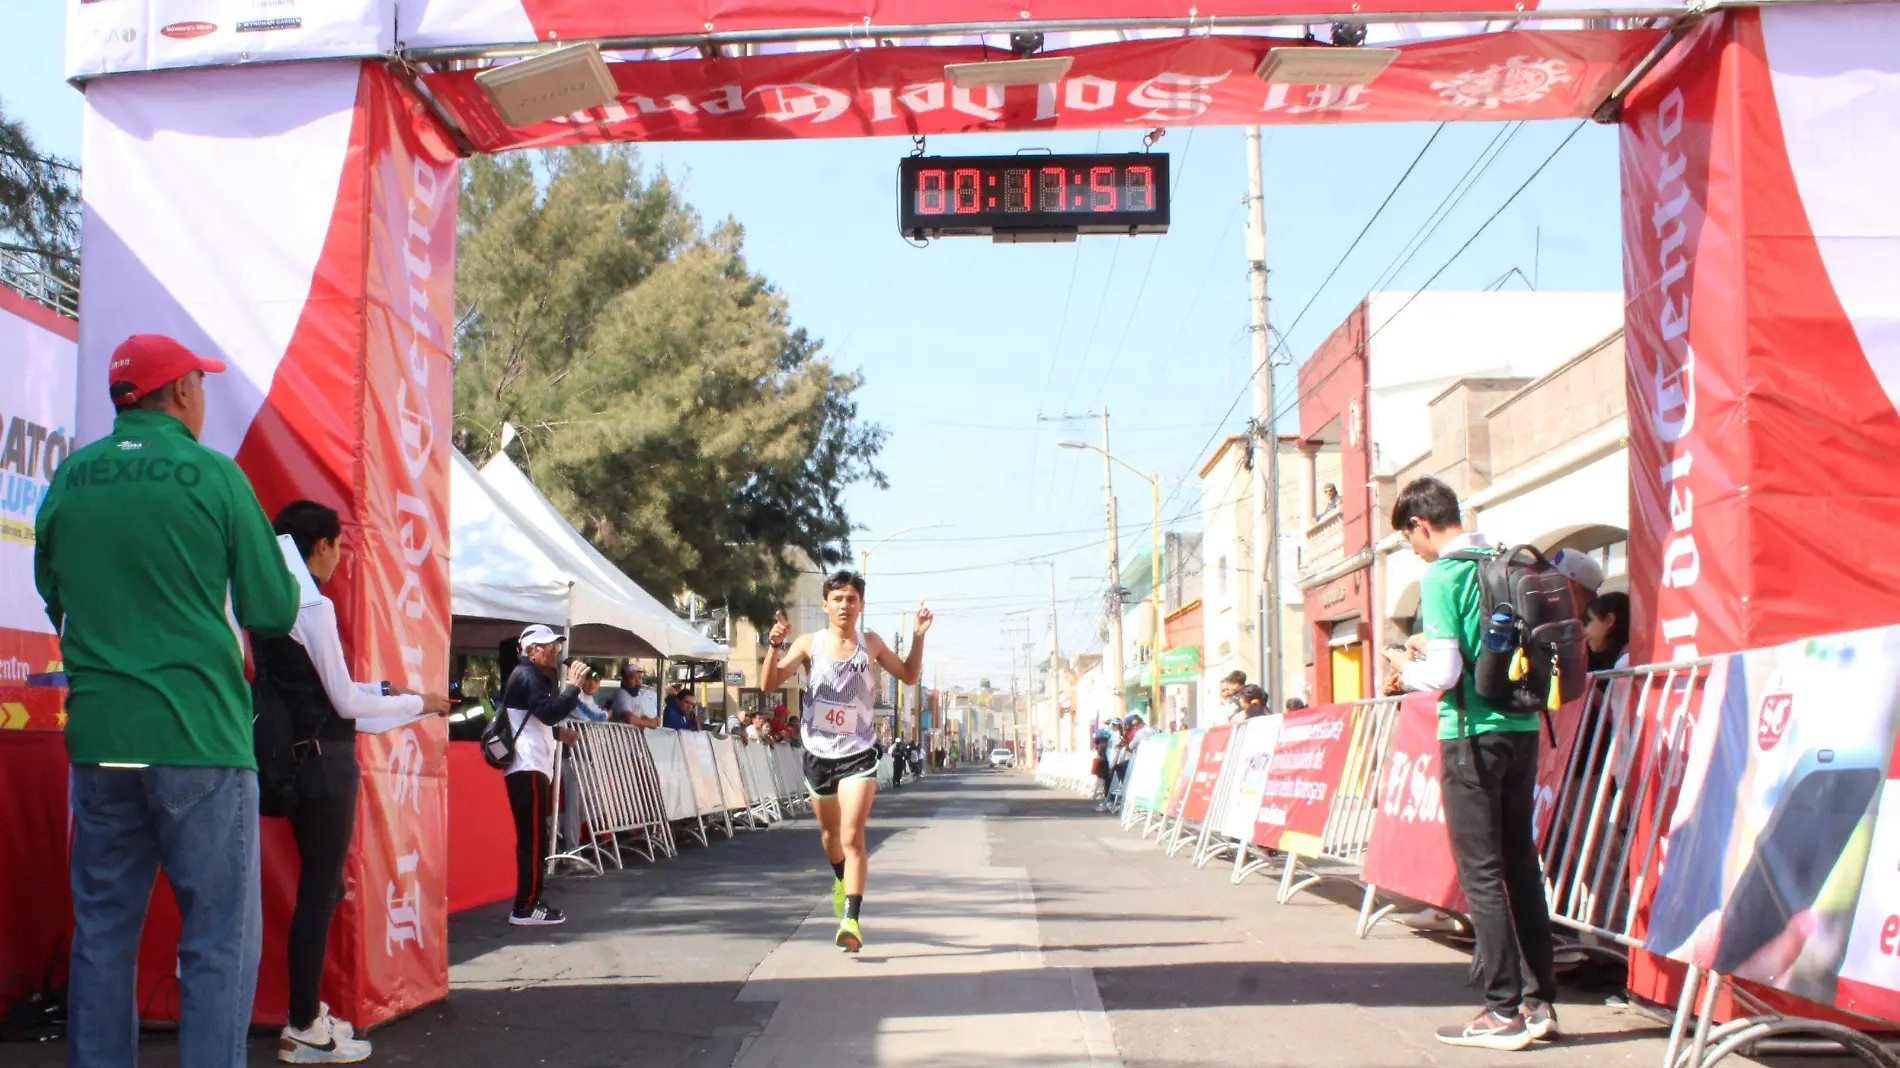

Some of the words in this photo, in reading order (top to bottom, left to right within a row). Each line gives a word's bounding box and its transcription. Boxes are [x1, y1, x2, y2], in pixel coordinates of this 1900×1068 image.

[917, 165, 1154, 214] 00:17:57
[397, 153, 438, 480] Centro
[1651, 86, 1696, 443] Centro
[0, 412, 77, 482] ATÓ
[66, 453, 202, 490] MÉXICO
[397, 489, 432, 619] del
[1660, 451, 1701, 589] del
[825, 708, 845, 727] 46
[386, 848, 425, 957] El
